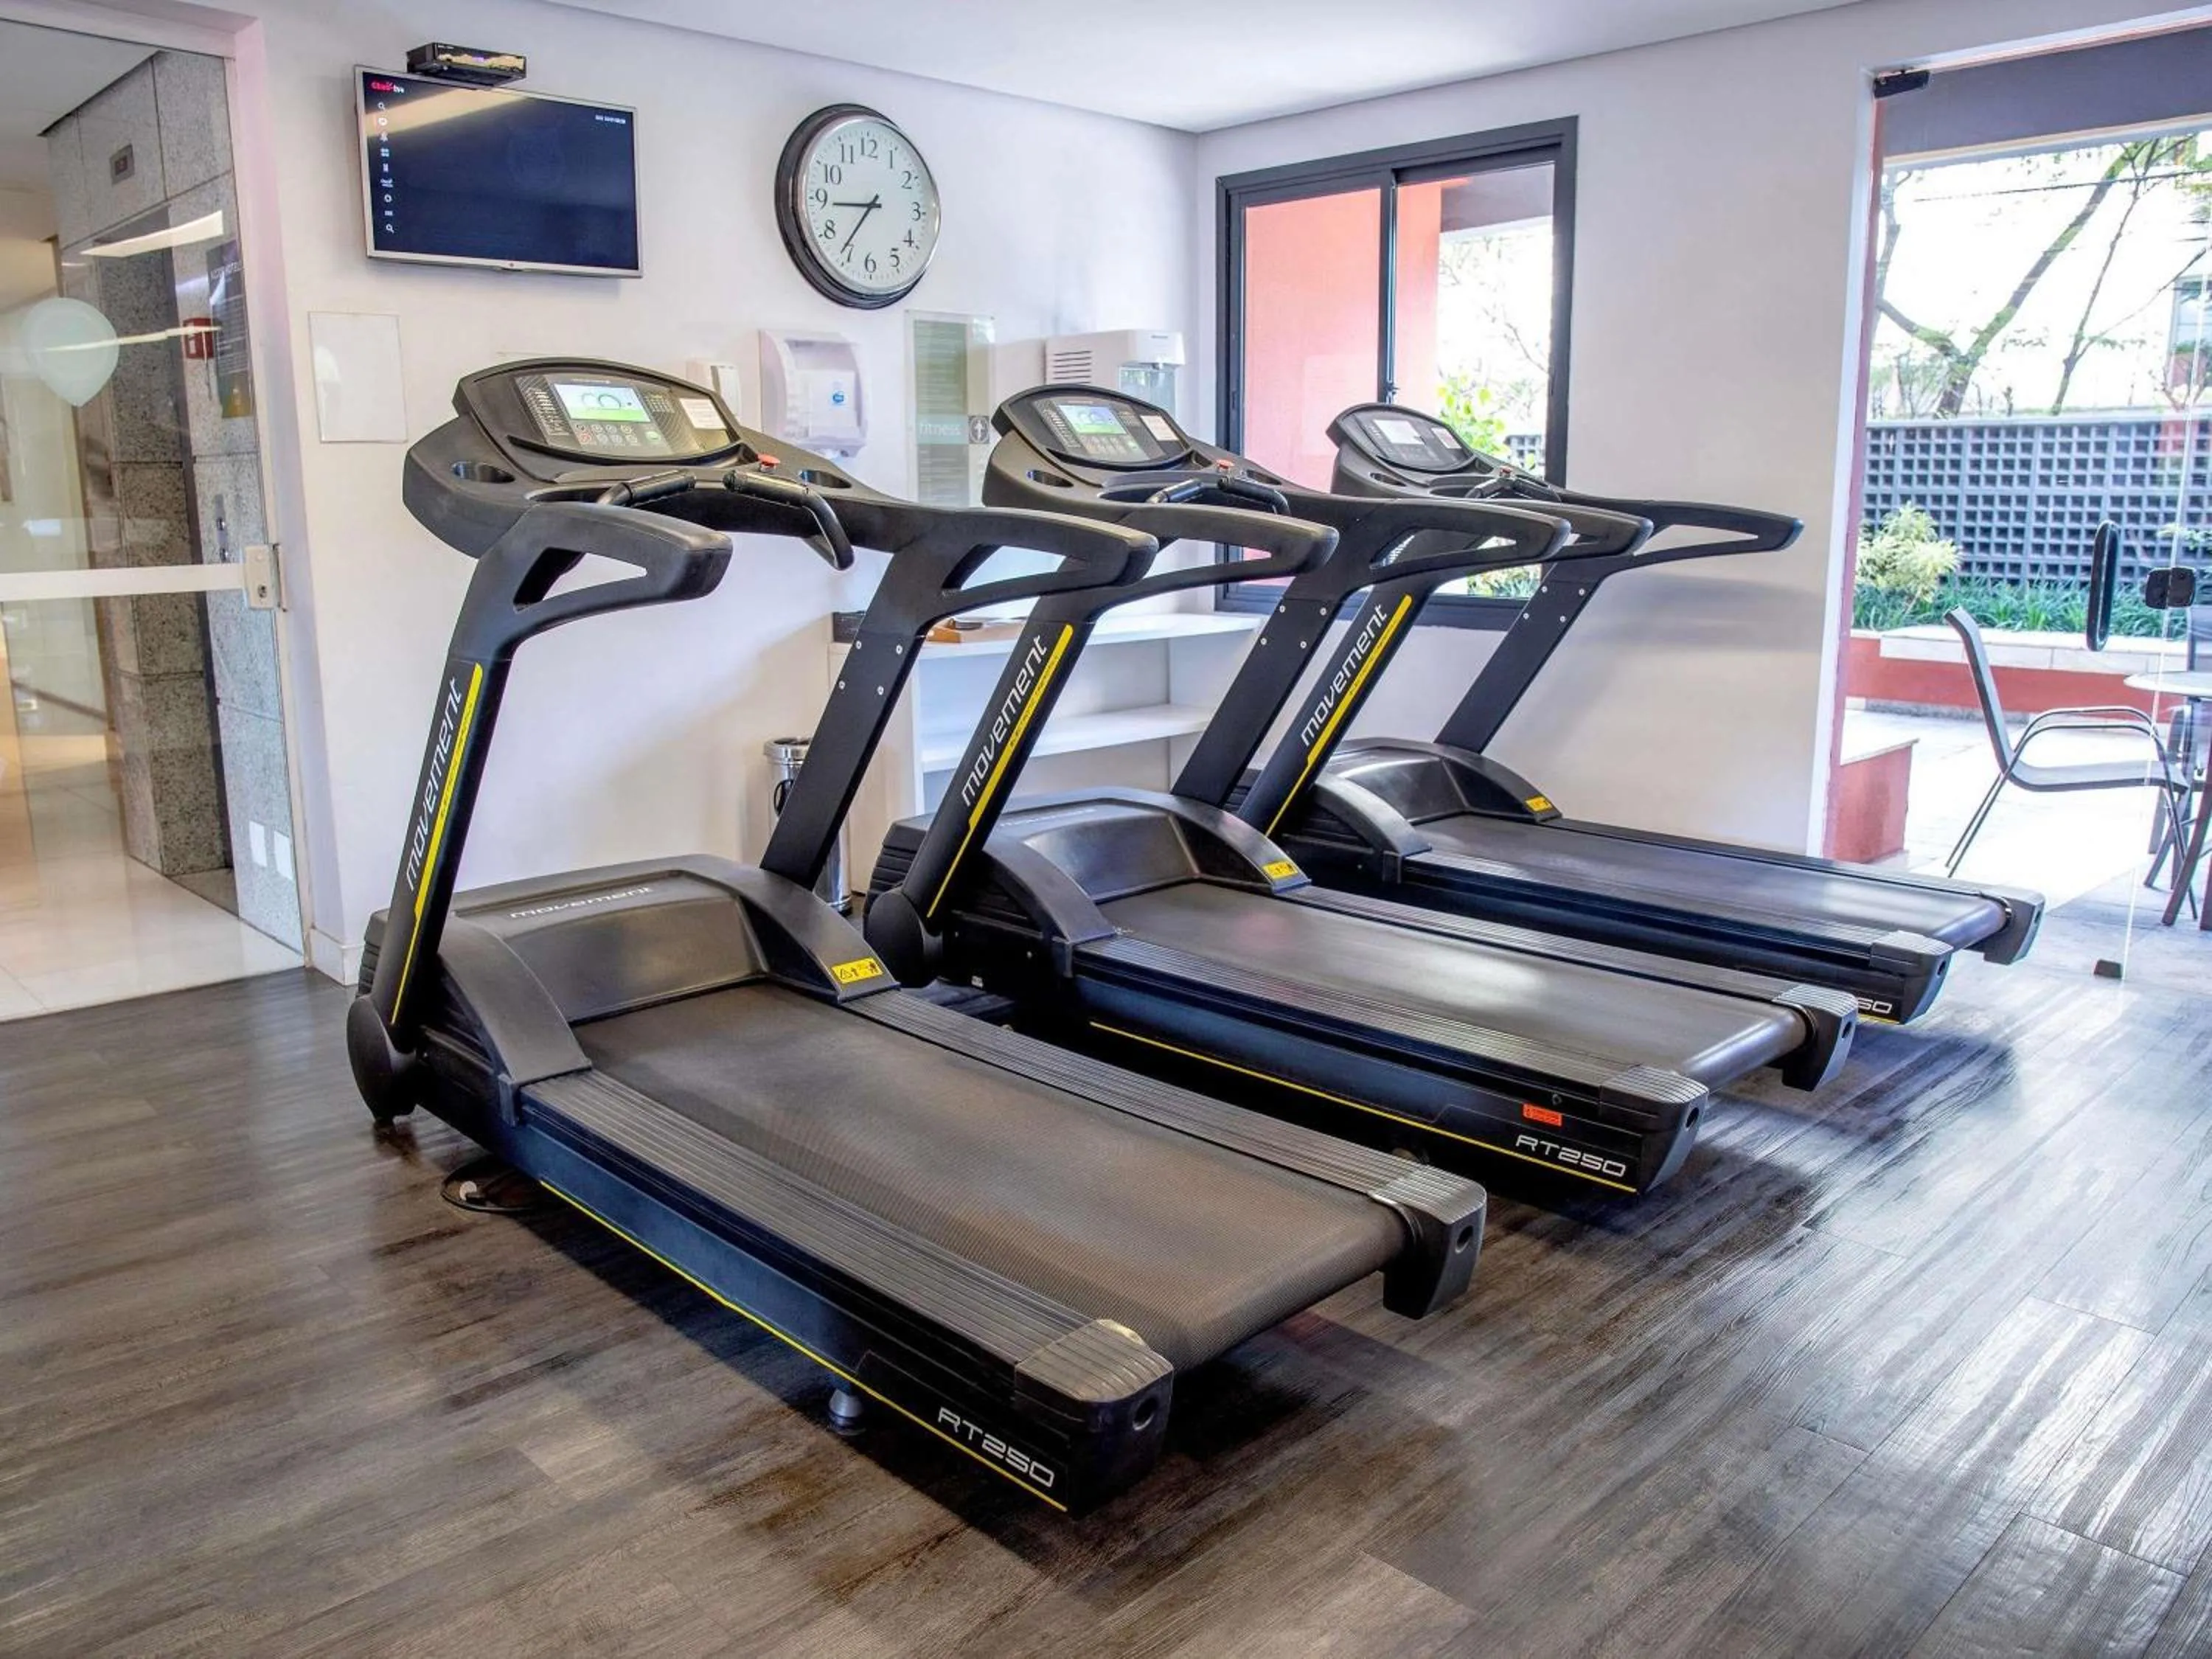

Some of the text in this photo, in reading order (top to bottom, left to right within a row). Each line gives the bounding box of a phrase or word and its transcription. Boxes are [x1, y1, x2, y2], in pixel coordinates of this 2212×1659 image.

[841, 143, 855, 164] 11
[860, 136, 878, 159] 12
[888, 150, 894, 169] 1
[824, 164, 842, 185] 10
[901, 171, 912, 189] 2
[815, 189, 828, 209] 9
[911, 202, 922, 221] 3
[824, 220, 836, 240] 8
[903, 229, 915, 248] 4
[844, 244, 854, 263] 7
[864, 251, 877, 273] 6
[889, 247, 900, 268] 5
[1300, 603, 1388, 747] movement
[961, 634, 1047, 807] movement
[406, 676, 462, 891] movement
[509, 886, 653, 919] movement
[1515, 1134, 1627, 1178] RT250
[937, 1406, 1055, 1488] RT250
